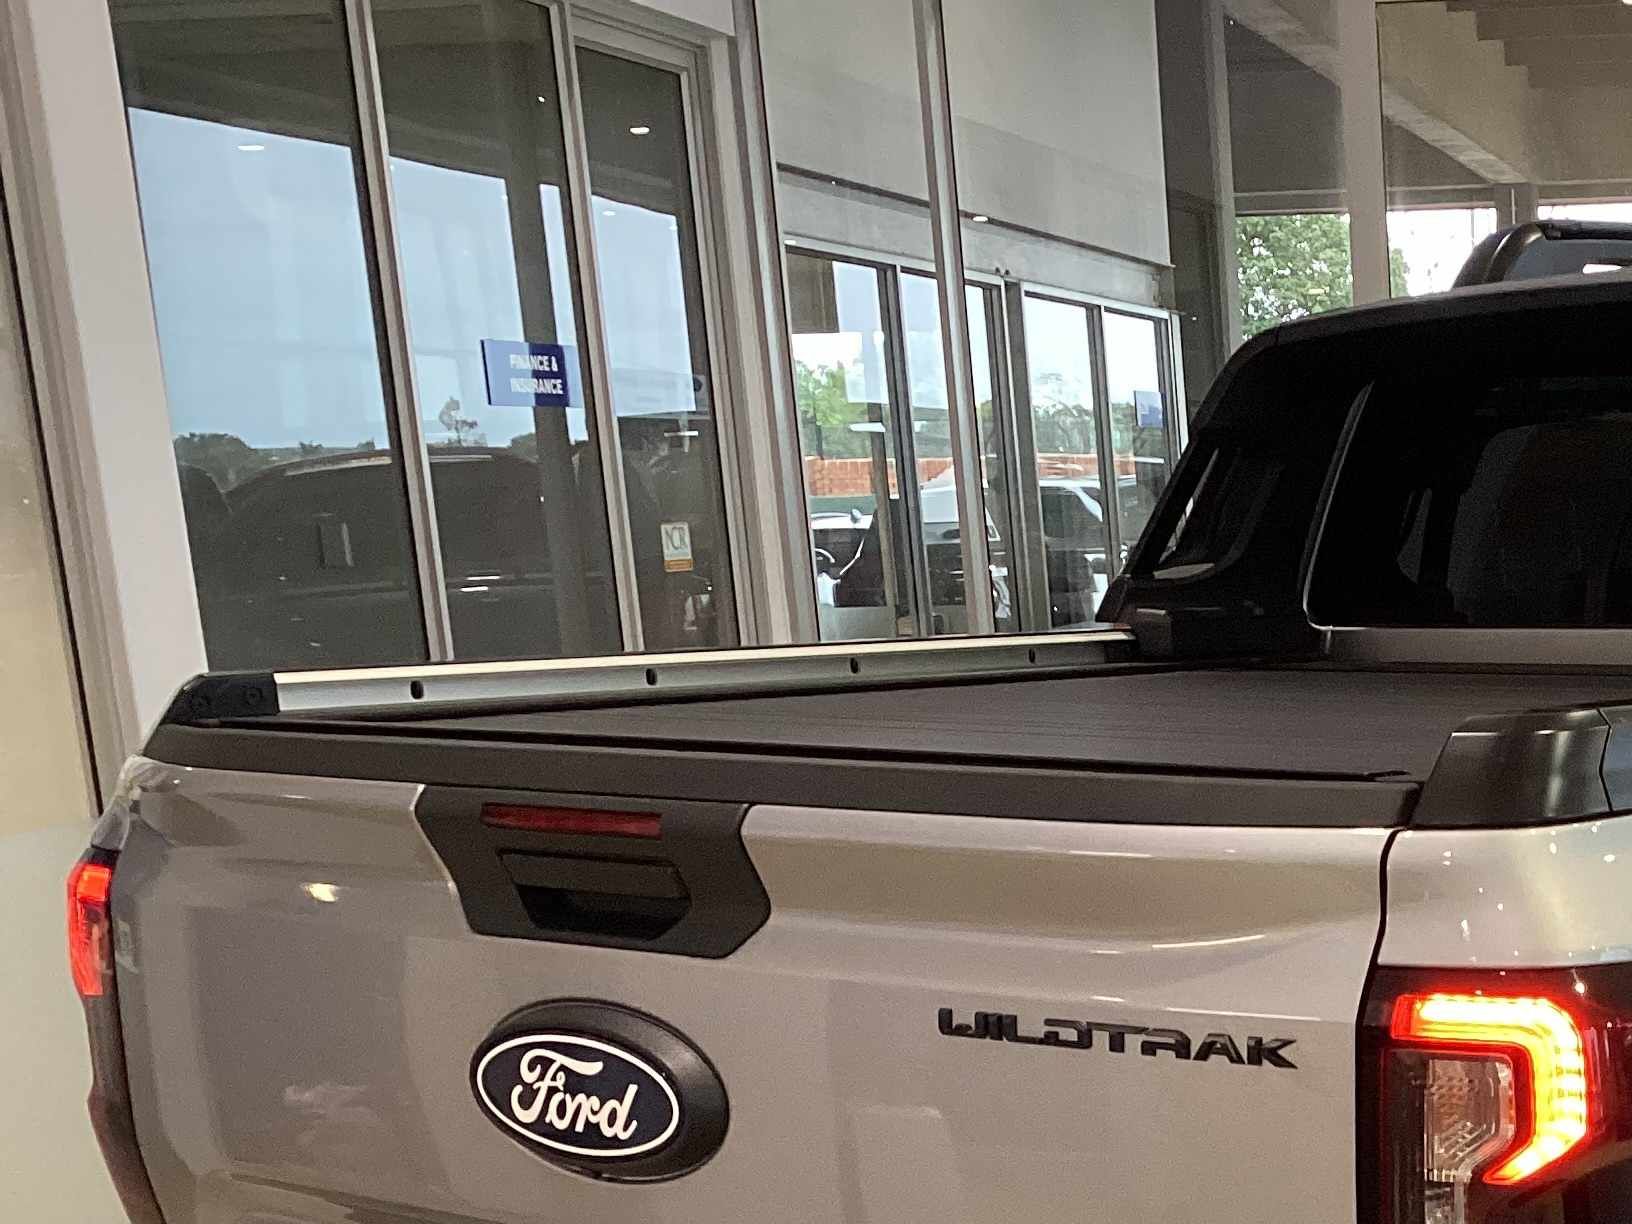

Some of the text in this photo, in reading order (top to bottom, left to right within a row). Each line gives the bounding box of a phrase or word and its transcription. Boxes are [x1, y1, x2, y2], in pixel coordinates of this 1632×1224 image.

[509, 353, 559, 372] FINANCE &
[510, 377, 564, 394] INSURANCE
[938, 1007, 1299, 1070] WILDTRAK
[510, 1048, 639, 1141] Ford
